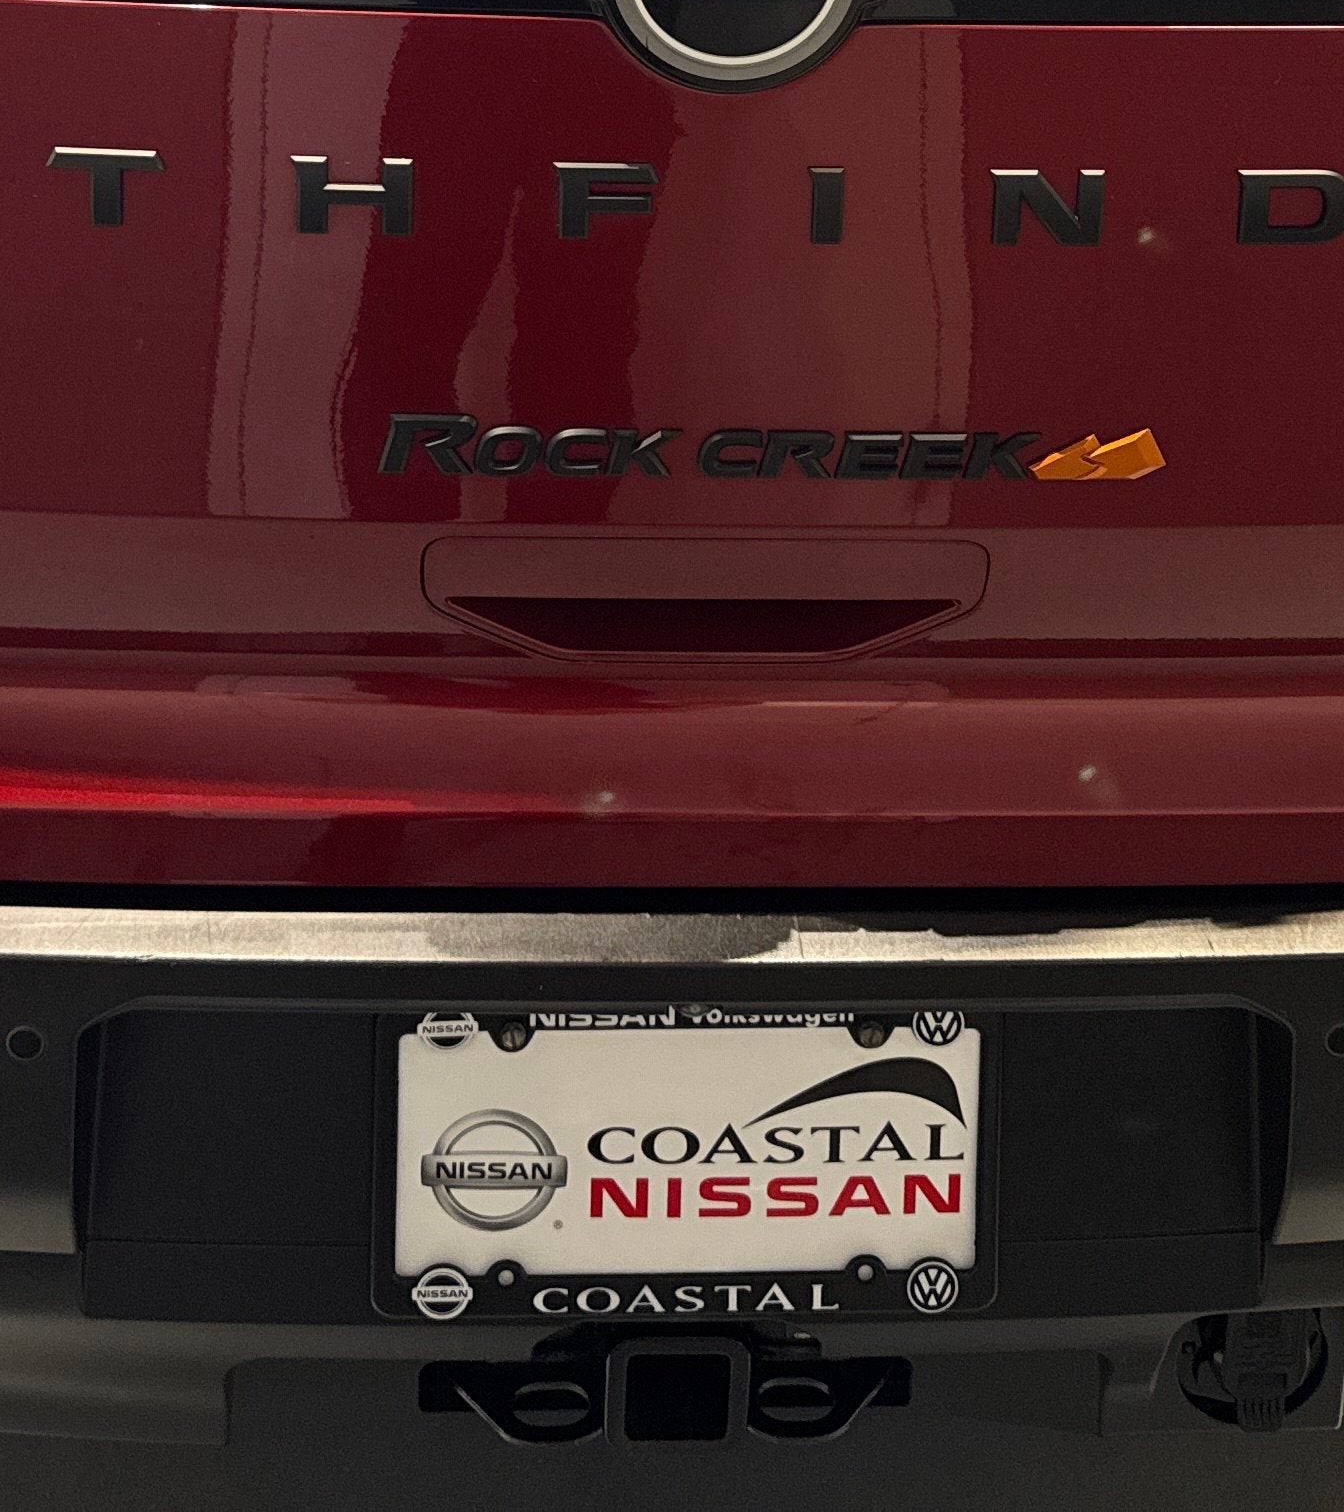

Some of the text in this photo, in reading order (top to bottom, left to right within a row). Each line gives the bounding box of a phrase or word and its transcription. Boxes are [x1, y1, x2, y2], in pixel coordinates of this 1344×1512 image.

[697, 428, 1042, 480] CREEK
[529, 1005, 675, 1027] NISSAN
[422, 1025, 474, 1034] NISSAN
[587, 1120, 964, 1165] COASTAL
[436, 1161, 552, 1180] NISSAN
[590, 1173, 961, 1218] NISSAN
[417, 1290, 468, 1298] NISSAN
[533, 1283, 839, 1313] COASTAL
